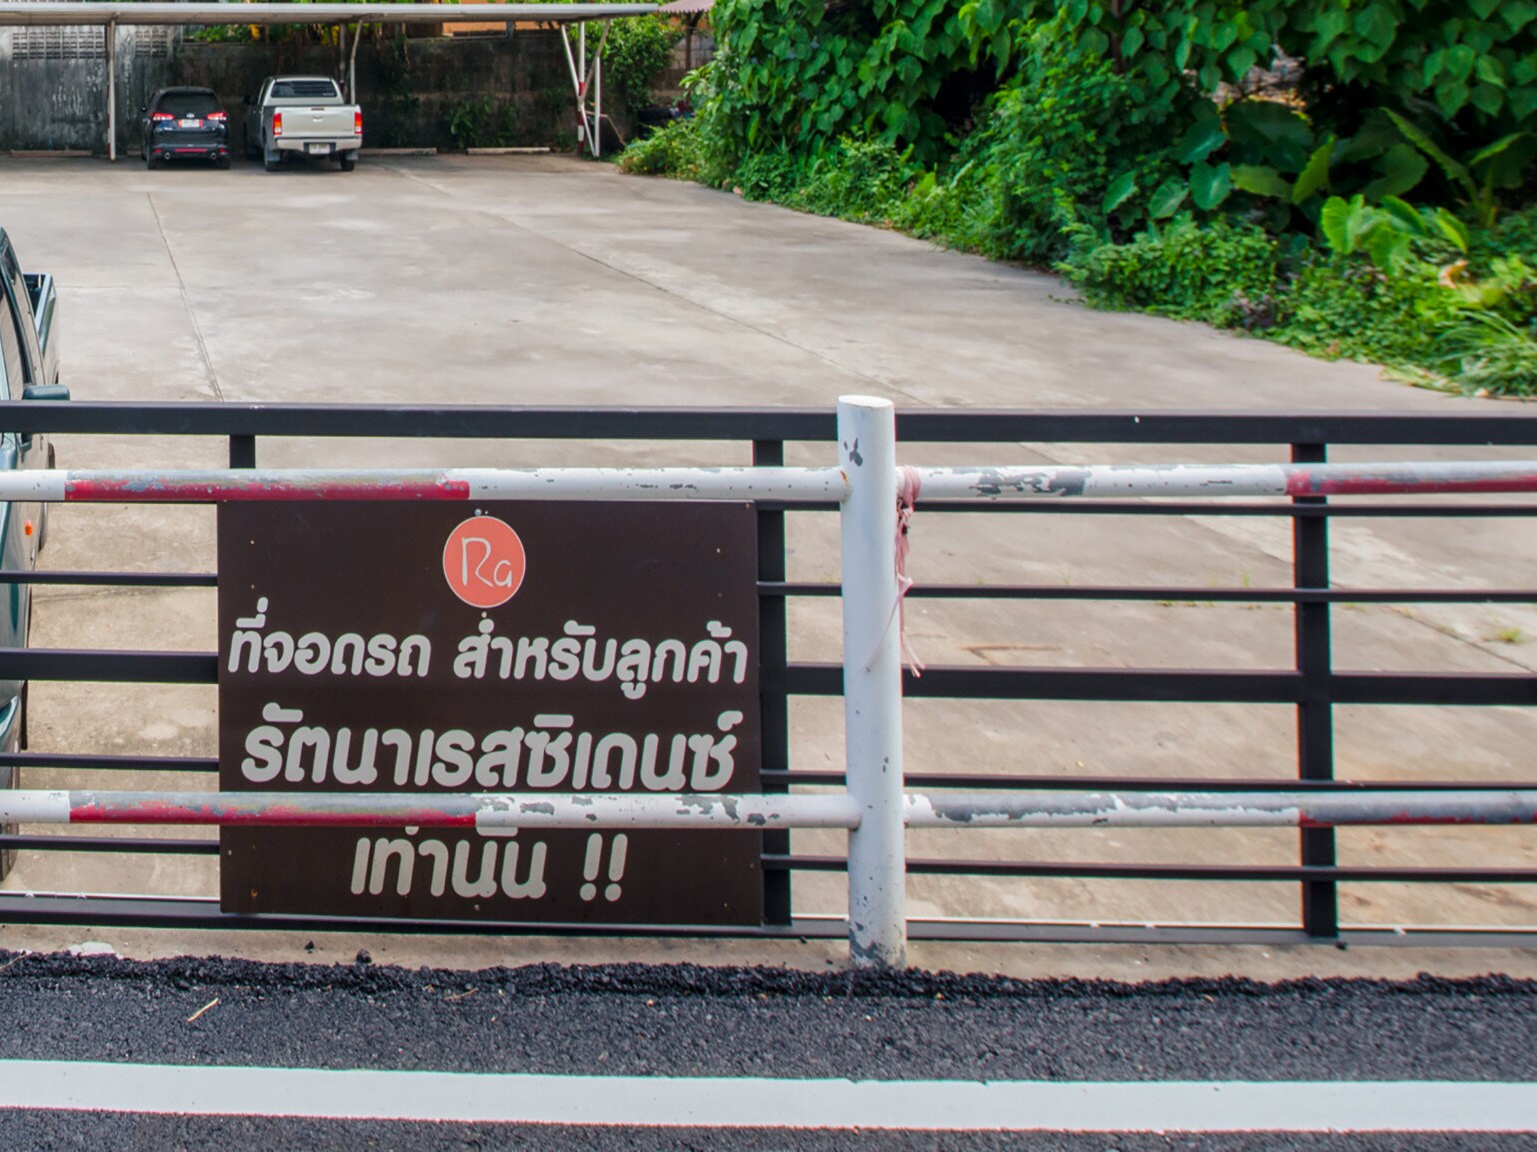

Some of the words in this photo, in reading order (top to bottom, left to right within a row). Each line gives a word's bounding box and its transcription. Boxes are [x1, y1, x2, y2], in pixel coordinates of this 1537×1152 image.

[227, 596, 432, 678] ที่จอดรถ
[453, 618, 749, 700] สำหรับลูกค้า
[240, 701, 744, 792] รัตนาเรสซิเดนซ์
[350, 825, 548, 899] เทานน
